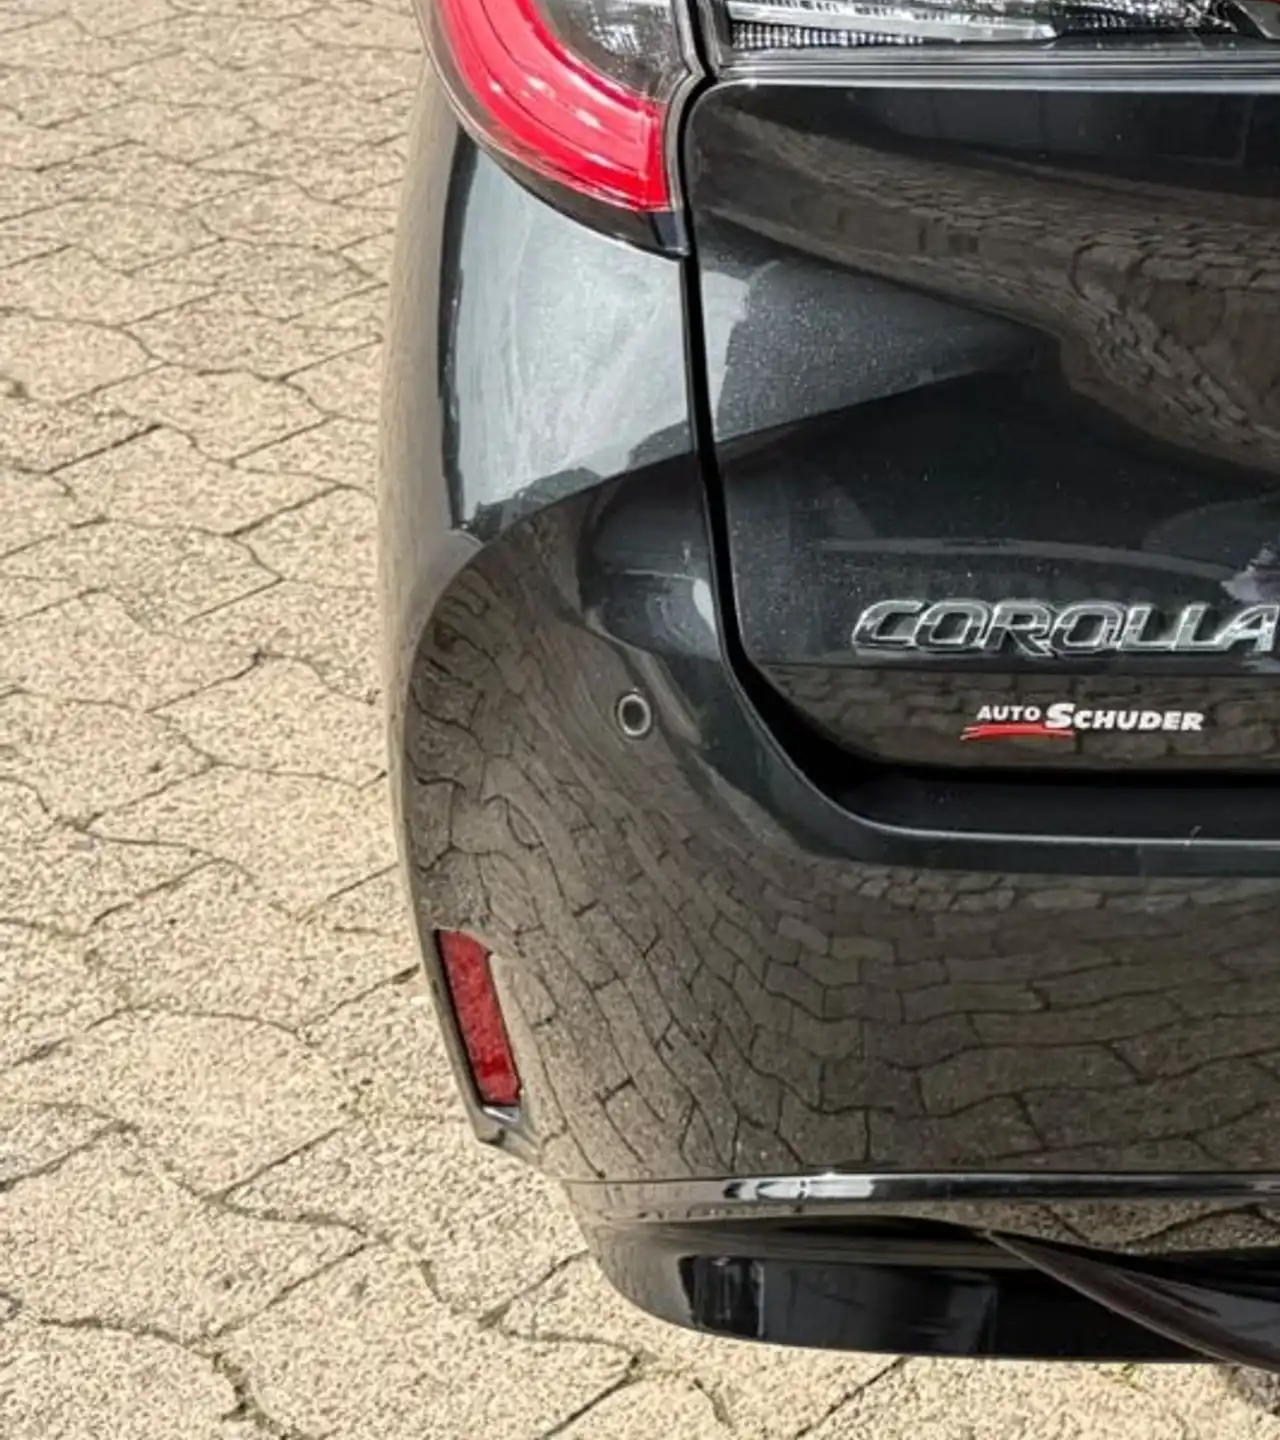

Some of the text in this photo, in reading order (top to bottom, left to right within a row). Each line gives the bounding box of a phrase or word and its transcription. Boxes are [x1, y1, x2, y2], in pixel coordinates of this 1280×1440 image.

[851, 598, 1280, 658] COROLLA
[976, 702, 1206, 731] AUTO SCHUDER
